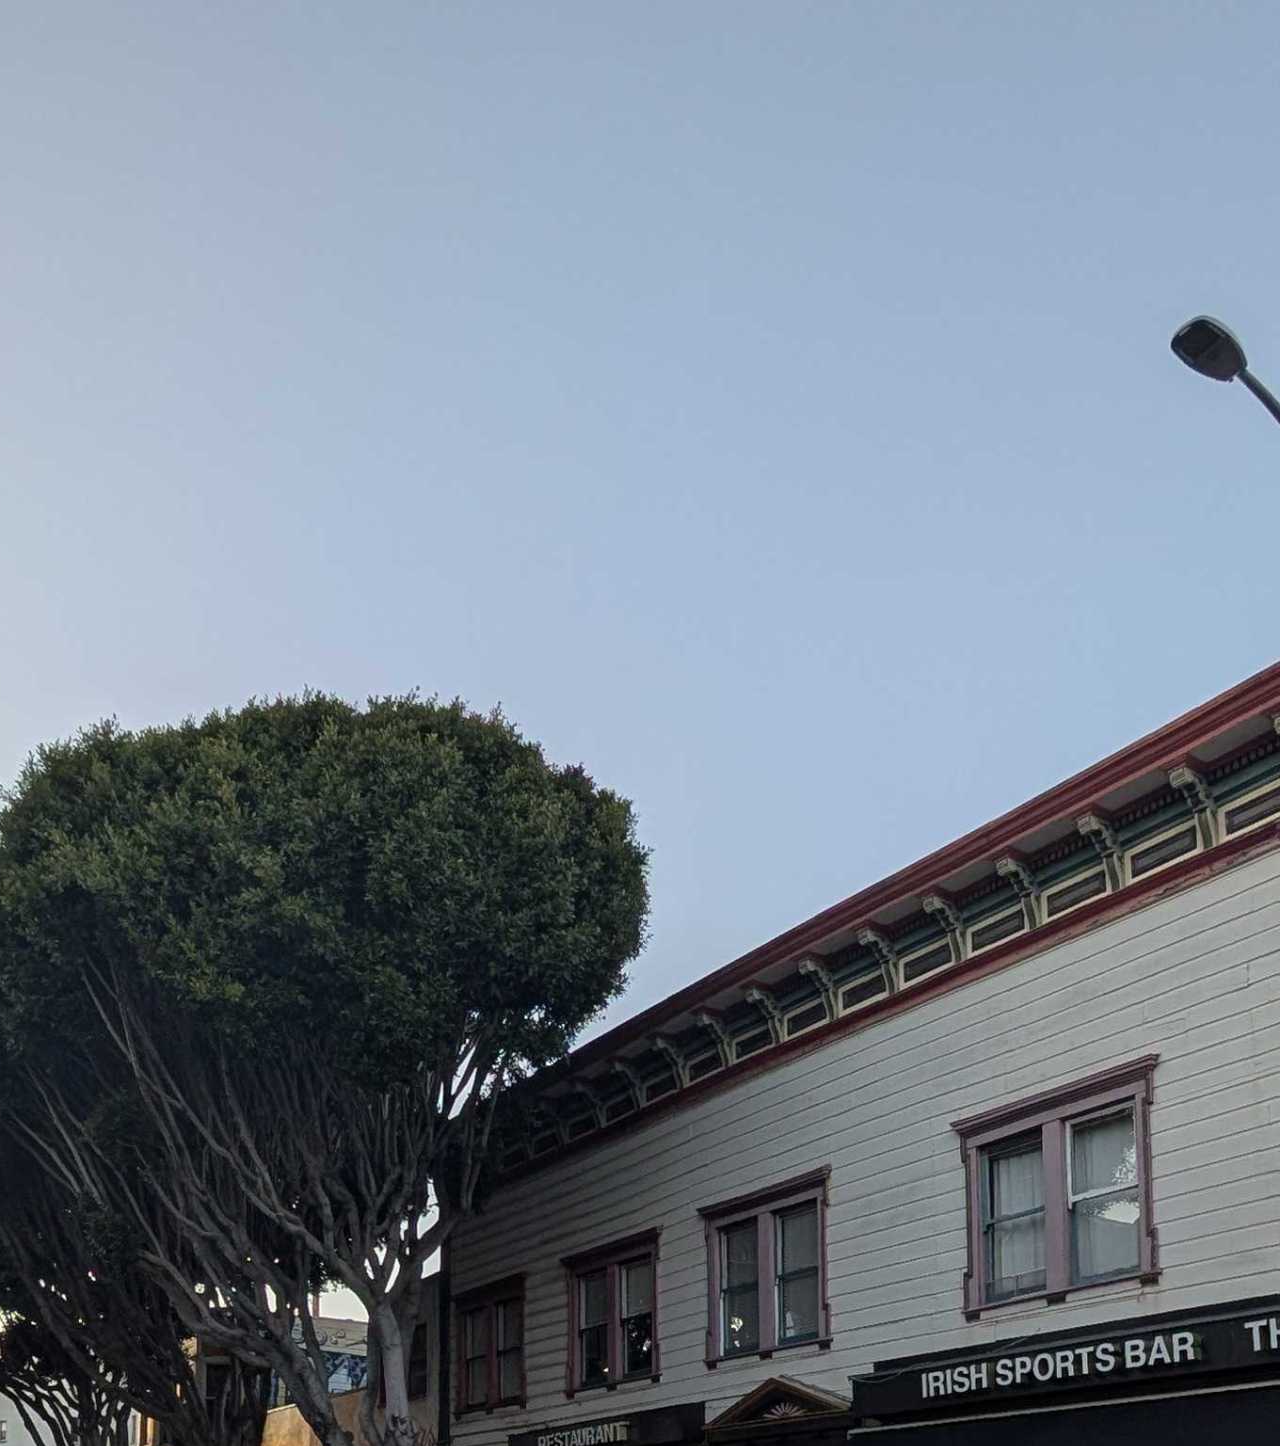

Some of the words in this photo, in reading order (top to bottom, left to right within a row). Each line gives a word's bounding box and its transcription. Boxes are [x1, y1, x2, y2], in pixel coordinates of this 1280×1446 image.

[921, 1363, 988, 1398] IRISH
[995, 1343, 1116, 1386] SPORTS
[1124, 1331, 1195, 1369] BAR
